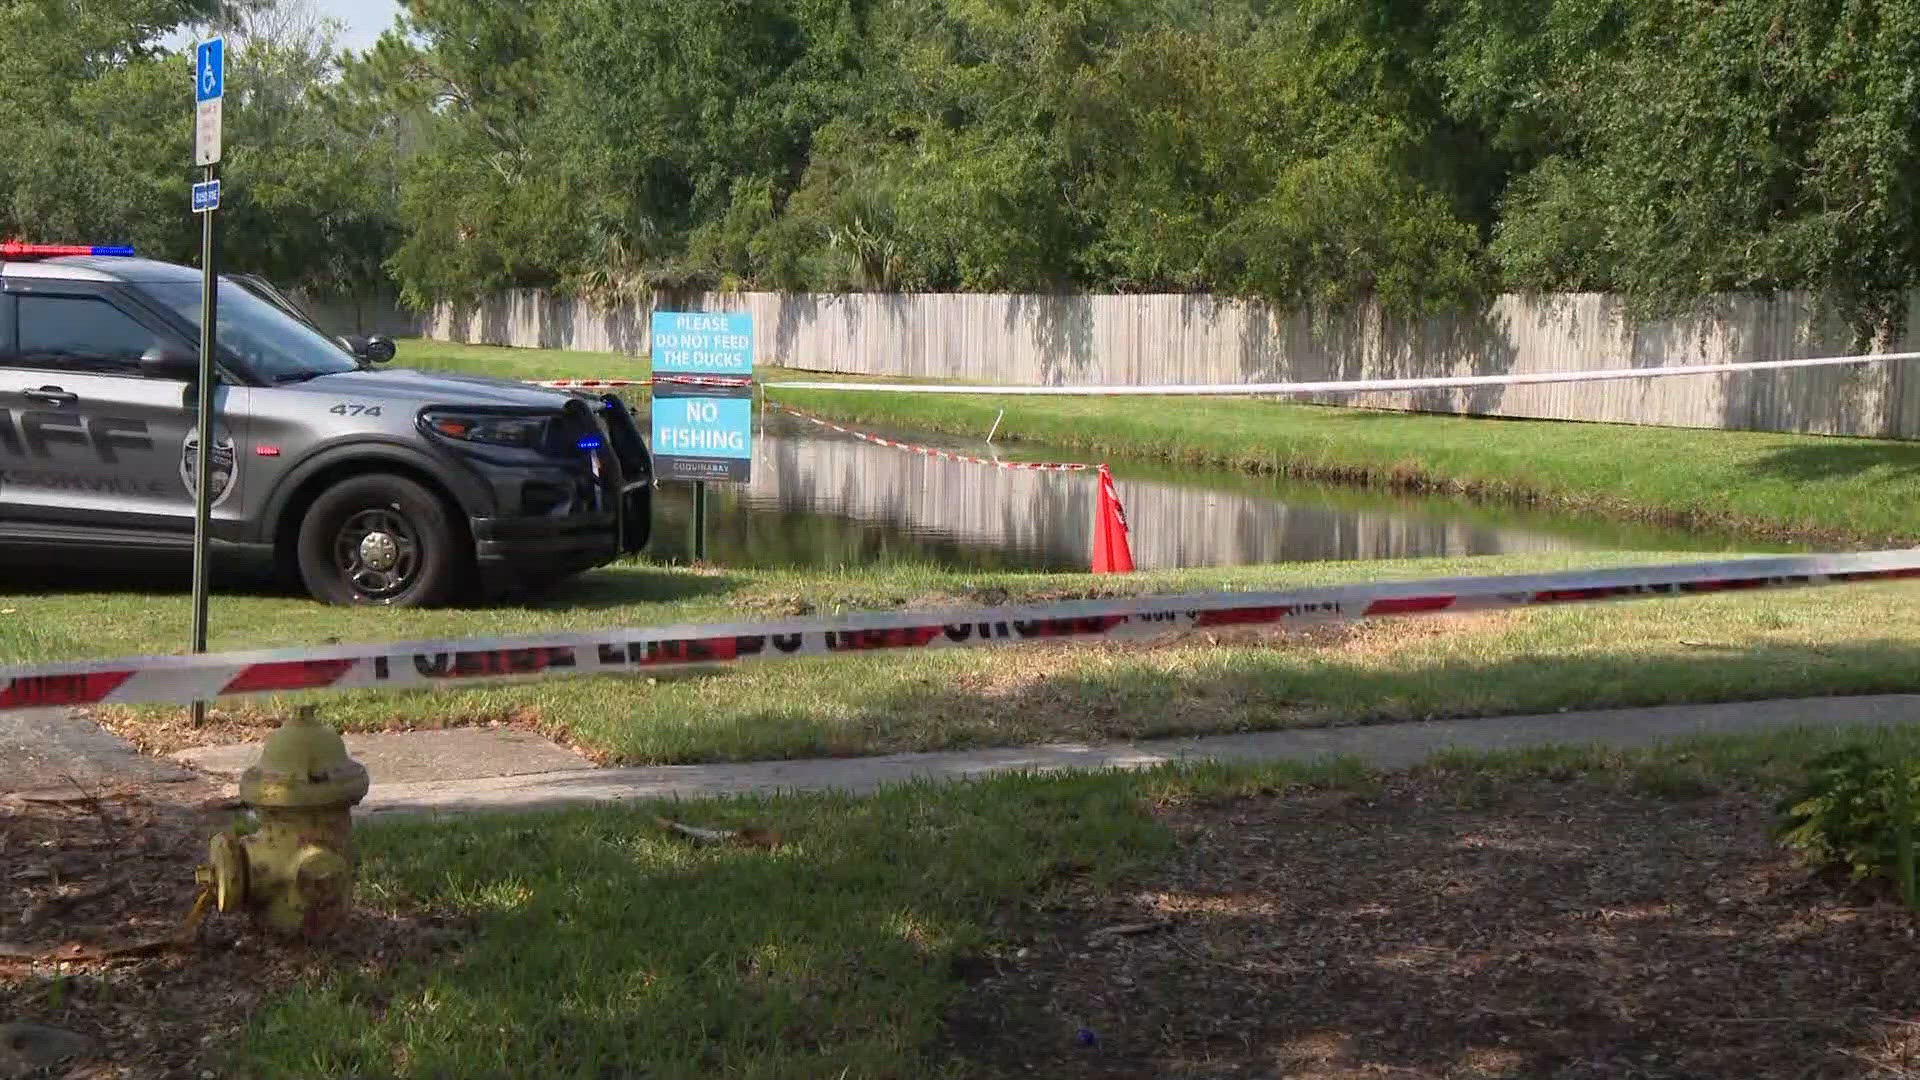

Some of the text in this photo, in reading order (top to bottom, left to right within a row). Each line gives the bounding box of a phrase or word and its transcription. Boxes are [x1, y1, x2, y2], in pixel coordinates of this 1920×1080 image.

[676, 316, 729, 332] PLEASE
[655, 334, 749, 349] DO NOT FEED
[664, 351, 744, 368] THE DUCKS
[329, 404, 382, 417] 474
[686, 401, 719, 423] NO
[660, 427, 744, 449] FISHING
